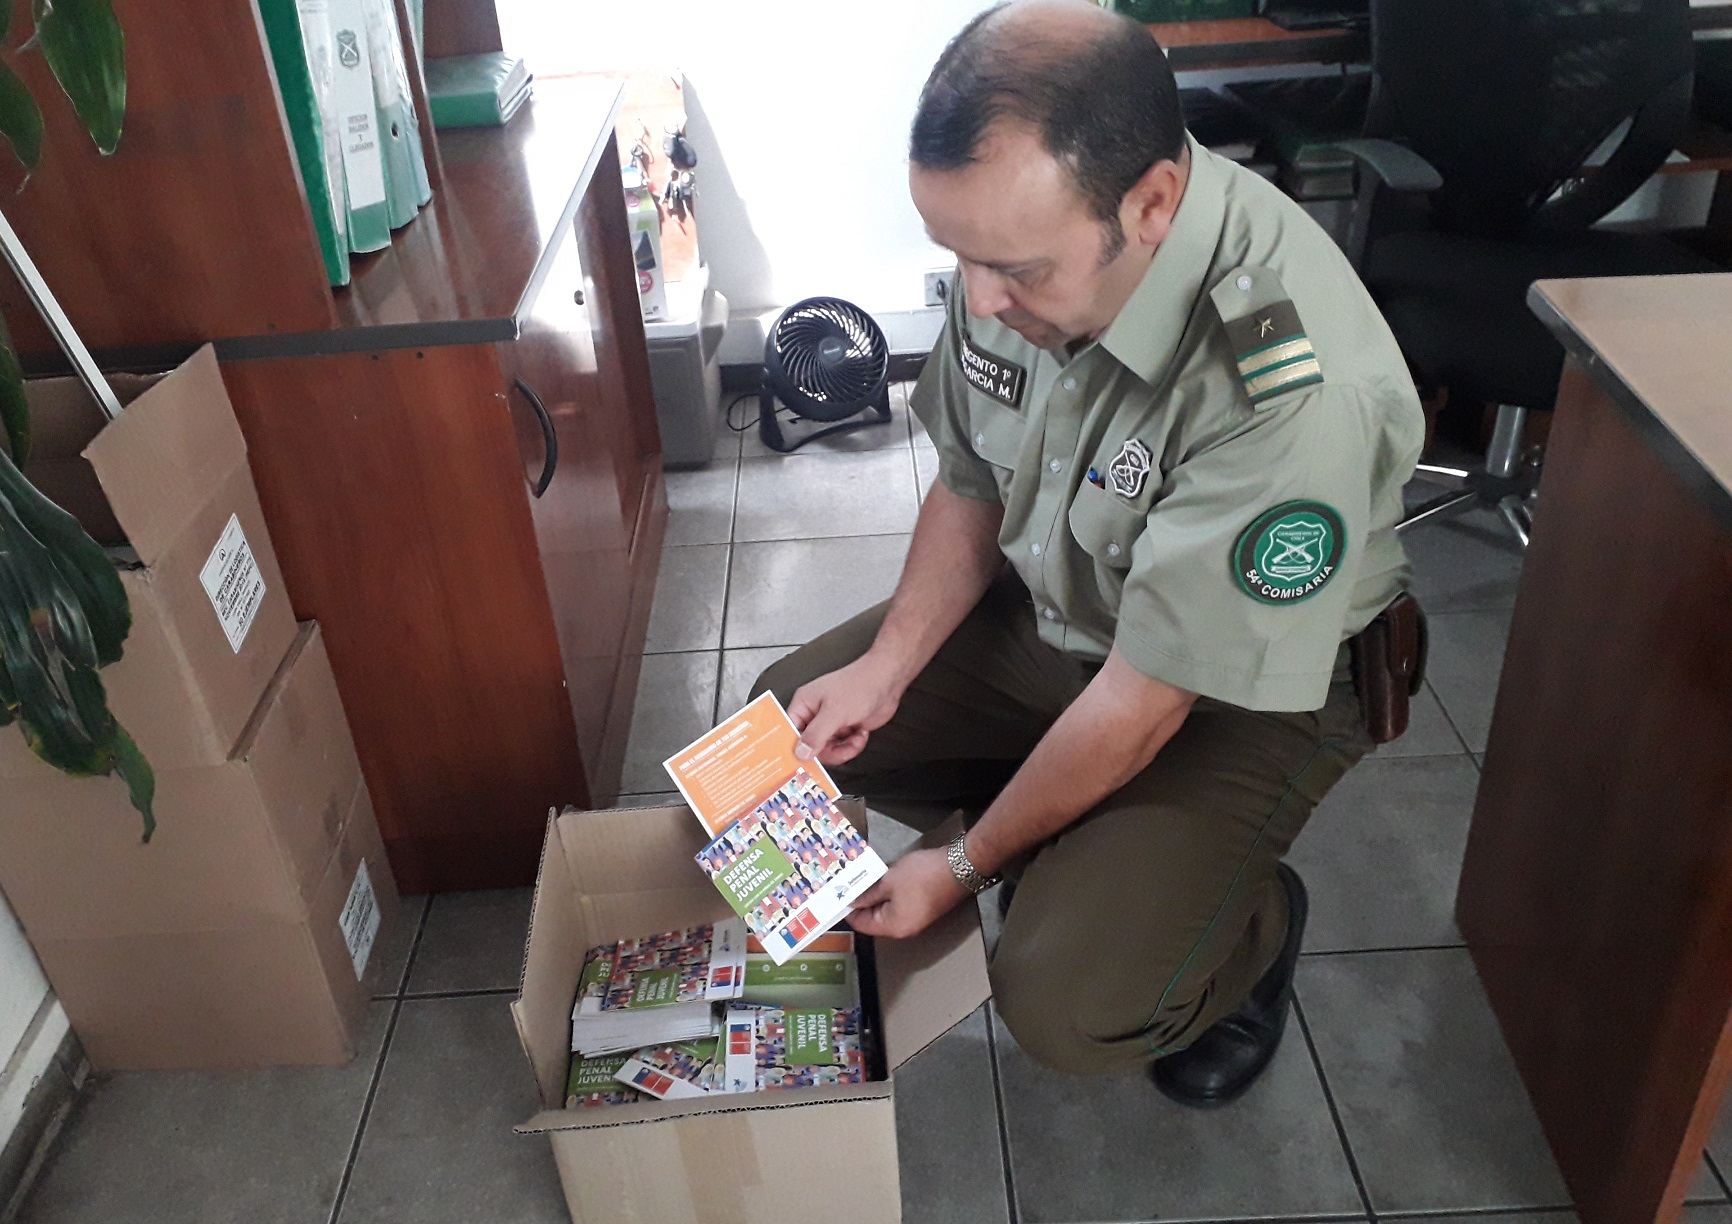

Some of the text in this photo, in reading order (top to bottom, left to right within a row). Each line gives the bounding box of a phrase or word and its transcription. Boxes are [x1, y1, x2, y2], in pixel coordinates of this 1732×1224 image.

[998, 383, 1010, 398] M.
[1261, 566, 1334, 599] COMISARIA
[723, 848, 764, 885] DEFENSA
[729, 866, 760, 893] PENAL
[736, 868, 774, 902] JUVENIL
[797, 1014, 806, 1050] JUVENIL
[808, 1014, 817, 1041] PENAL
[818, 1014, 828, 1052] DEFENSA
[578, 1074, 613, 1084] JUVENI
[580, 1066, 611, 1075] PENAL
